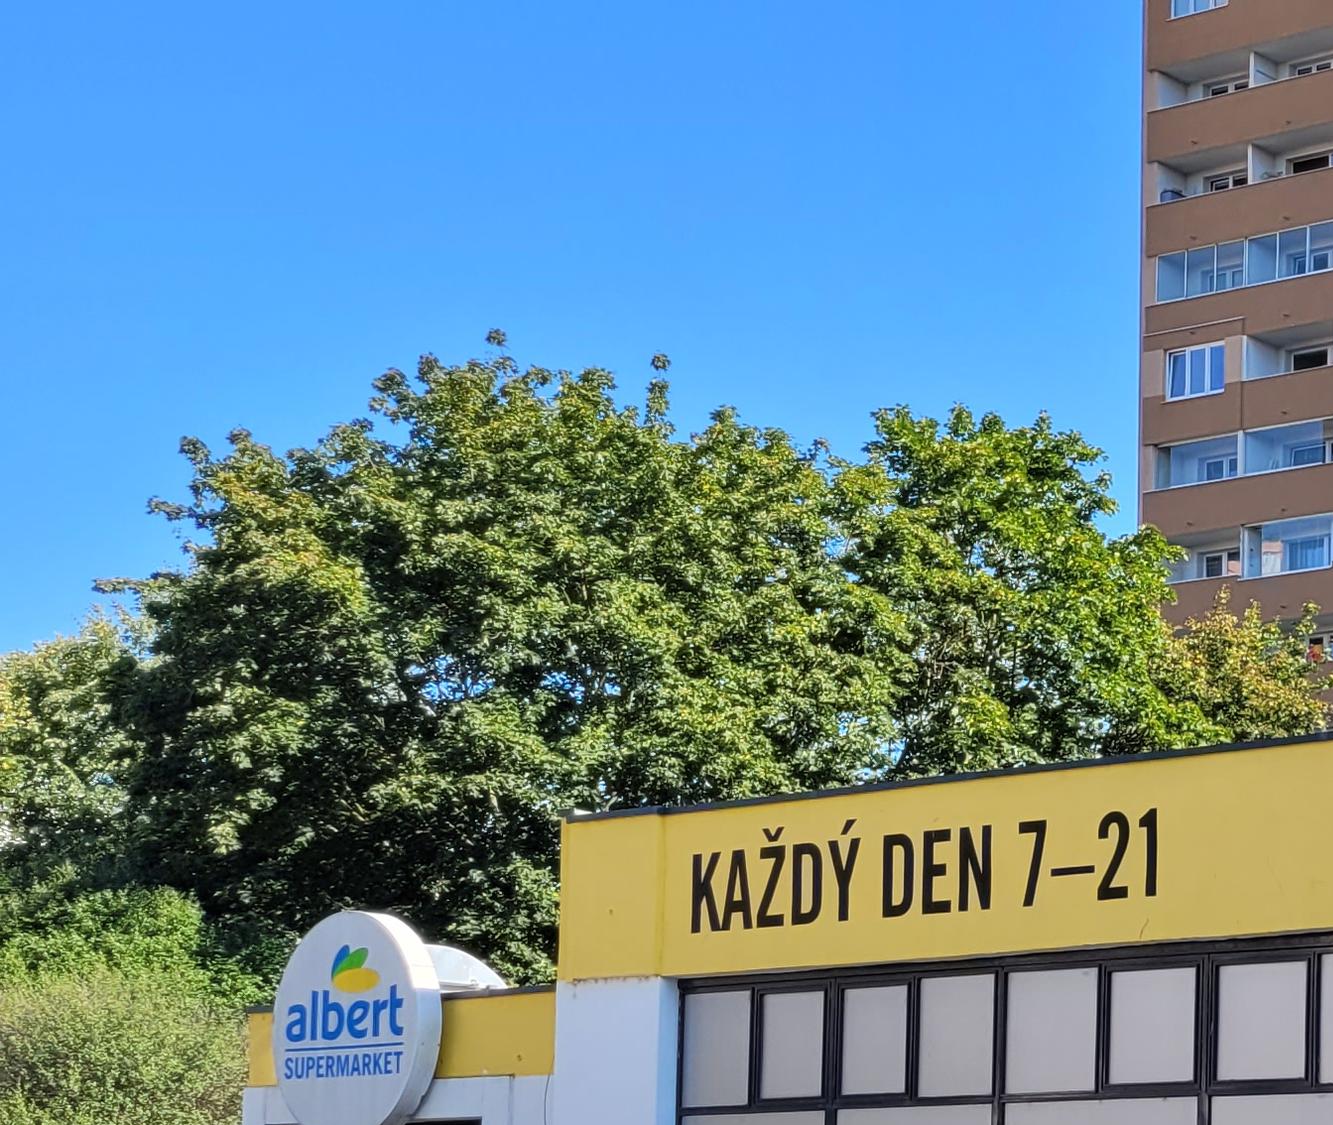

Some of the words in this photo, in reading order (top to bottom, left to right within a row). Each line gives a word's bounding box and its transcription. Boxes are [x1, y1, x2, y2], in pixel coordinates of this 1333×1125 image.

[690, 818, 861, 934] KAŽDÝ
[881, 824, 993, 919] DEN
[285, 984, 404, 1043] albert
[284, 1051, 403, 1080] SUPERMARKET
